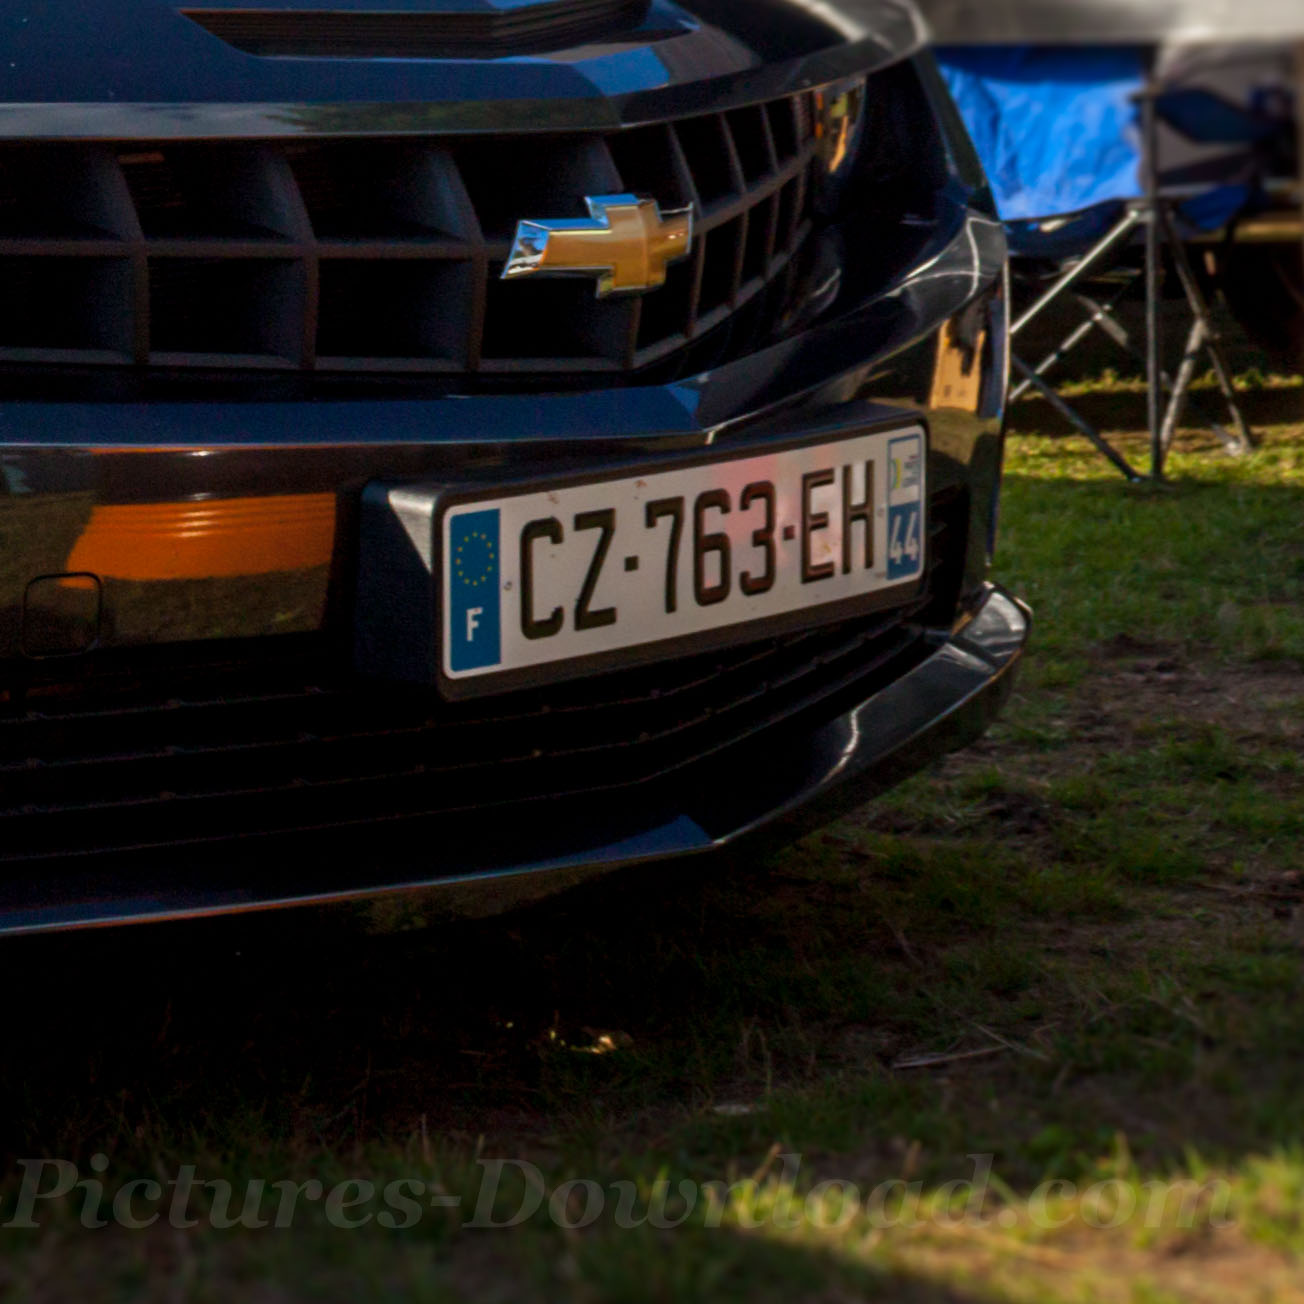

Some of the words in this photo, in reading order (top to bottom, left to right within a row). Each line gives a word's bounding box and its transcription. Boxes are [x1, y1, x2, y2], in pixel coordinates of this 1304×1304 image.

[466, 607, 483, 642] F
[520, 459, 875, 640] CZ-763-EH
[890, 511, 920, 565] 44
